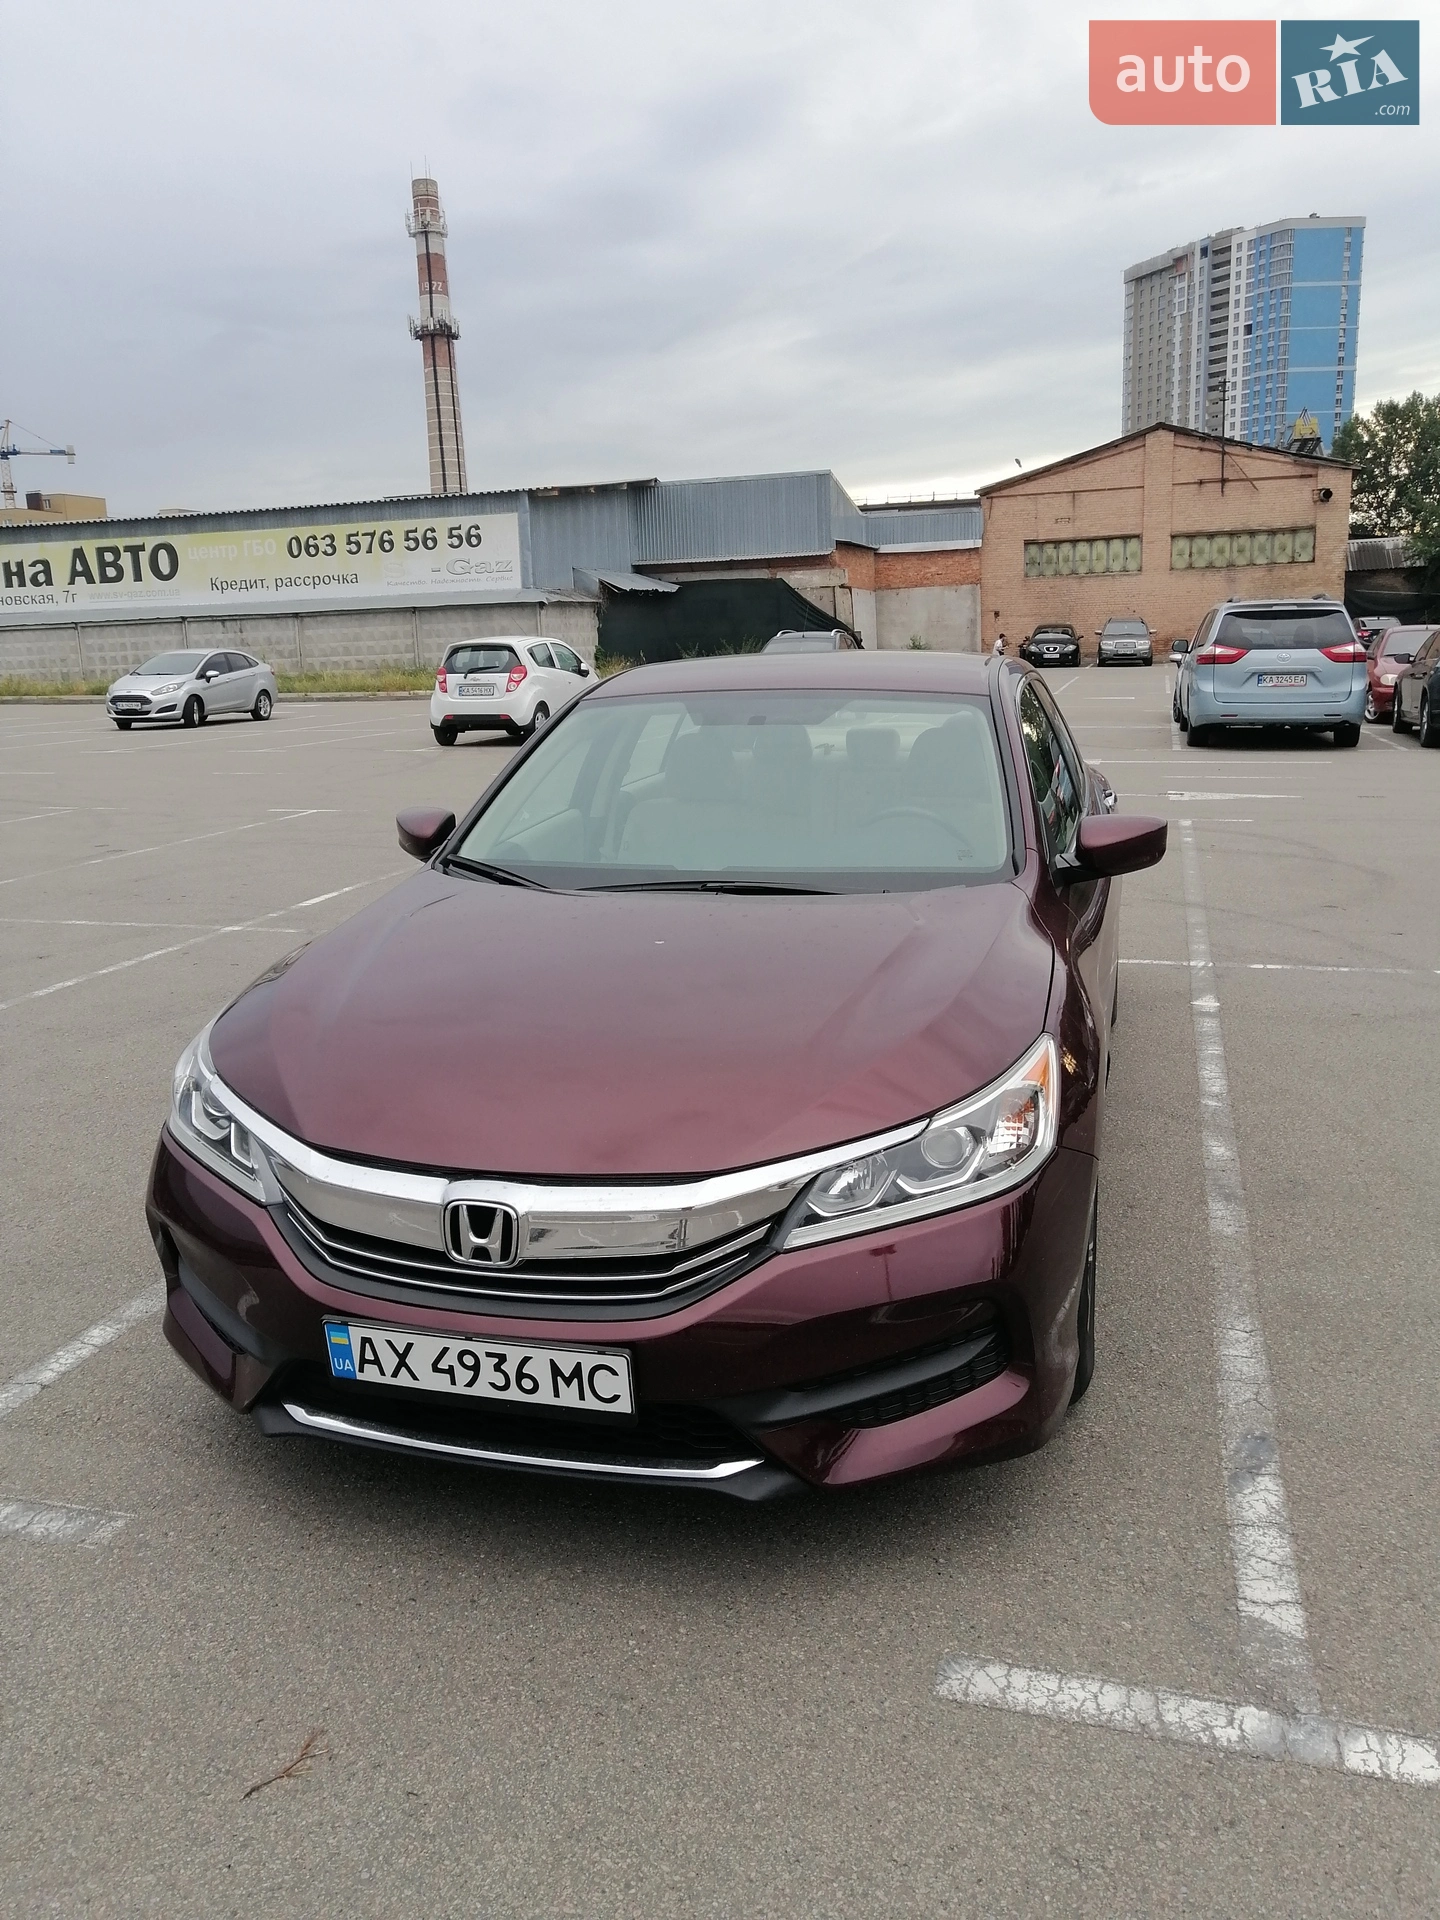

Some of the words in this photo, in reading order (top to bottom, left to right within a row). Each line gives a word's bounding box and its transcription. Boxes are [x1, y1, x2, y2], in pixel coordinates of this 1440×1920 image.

[421, 281, 443, 291] 1972
[188, 544, 238, 561] центр
[243, 538, 277, 557] ГБО
[286, 533, 337, 558] 063
[345, 529, 395, 555] 576
[403, 526, 438, 551] 56
[447, 523, 482, 549] 56
[2, 558, 54, 588] на
[67, 541, 179, 585] АВТО
[210, 576, 269, 594] Кредит,
[274, 572, 359, 591] рассрочка
[486, 575, 513, 583] Сервис
[62, 590, 78, 604] 7г
[1262, 676, 1274, 684] KA
[1275, 676, 1293, 684] 3245
[1294, 676, 1305, 684] EA
[334, 1357, 354, 1371] UA
[358, 1336, 420, 1381] AX
[431, 1346, 540, 1395] 4936
[549, 1358, 622, 1403] MC
